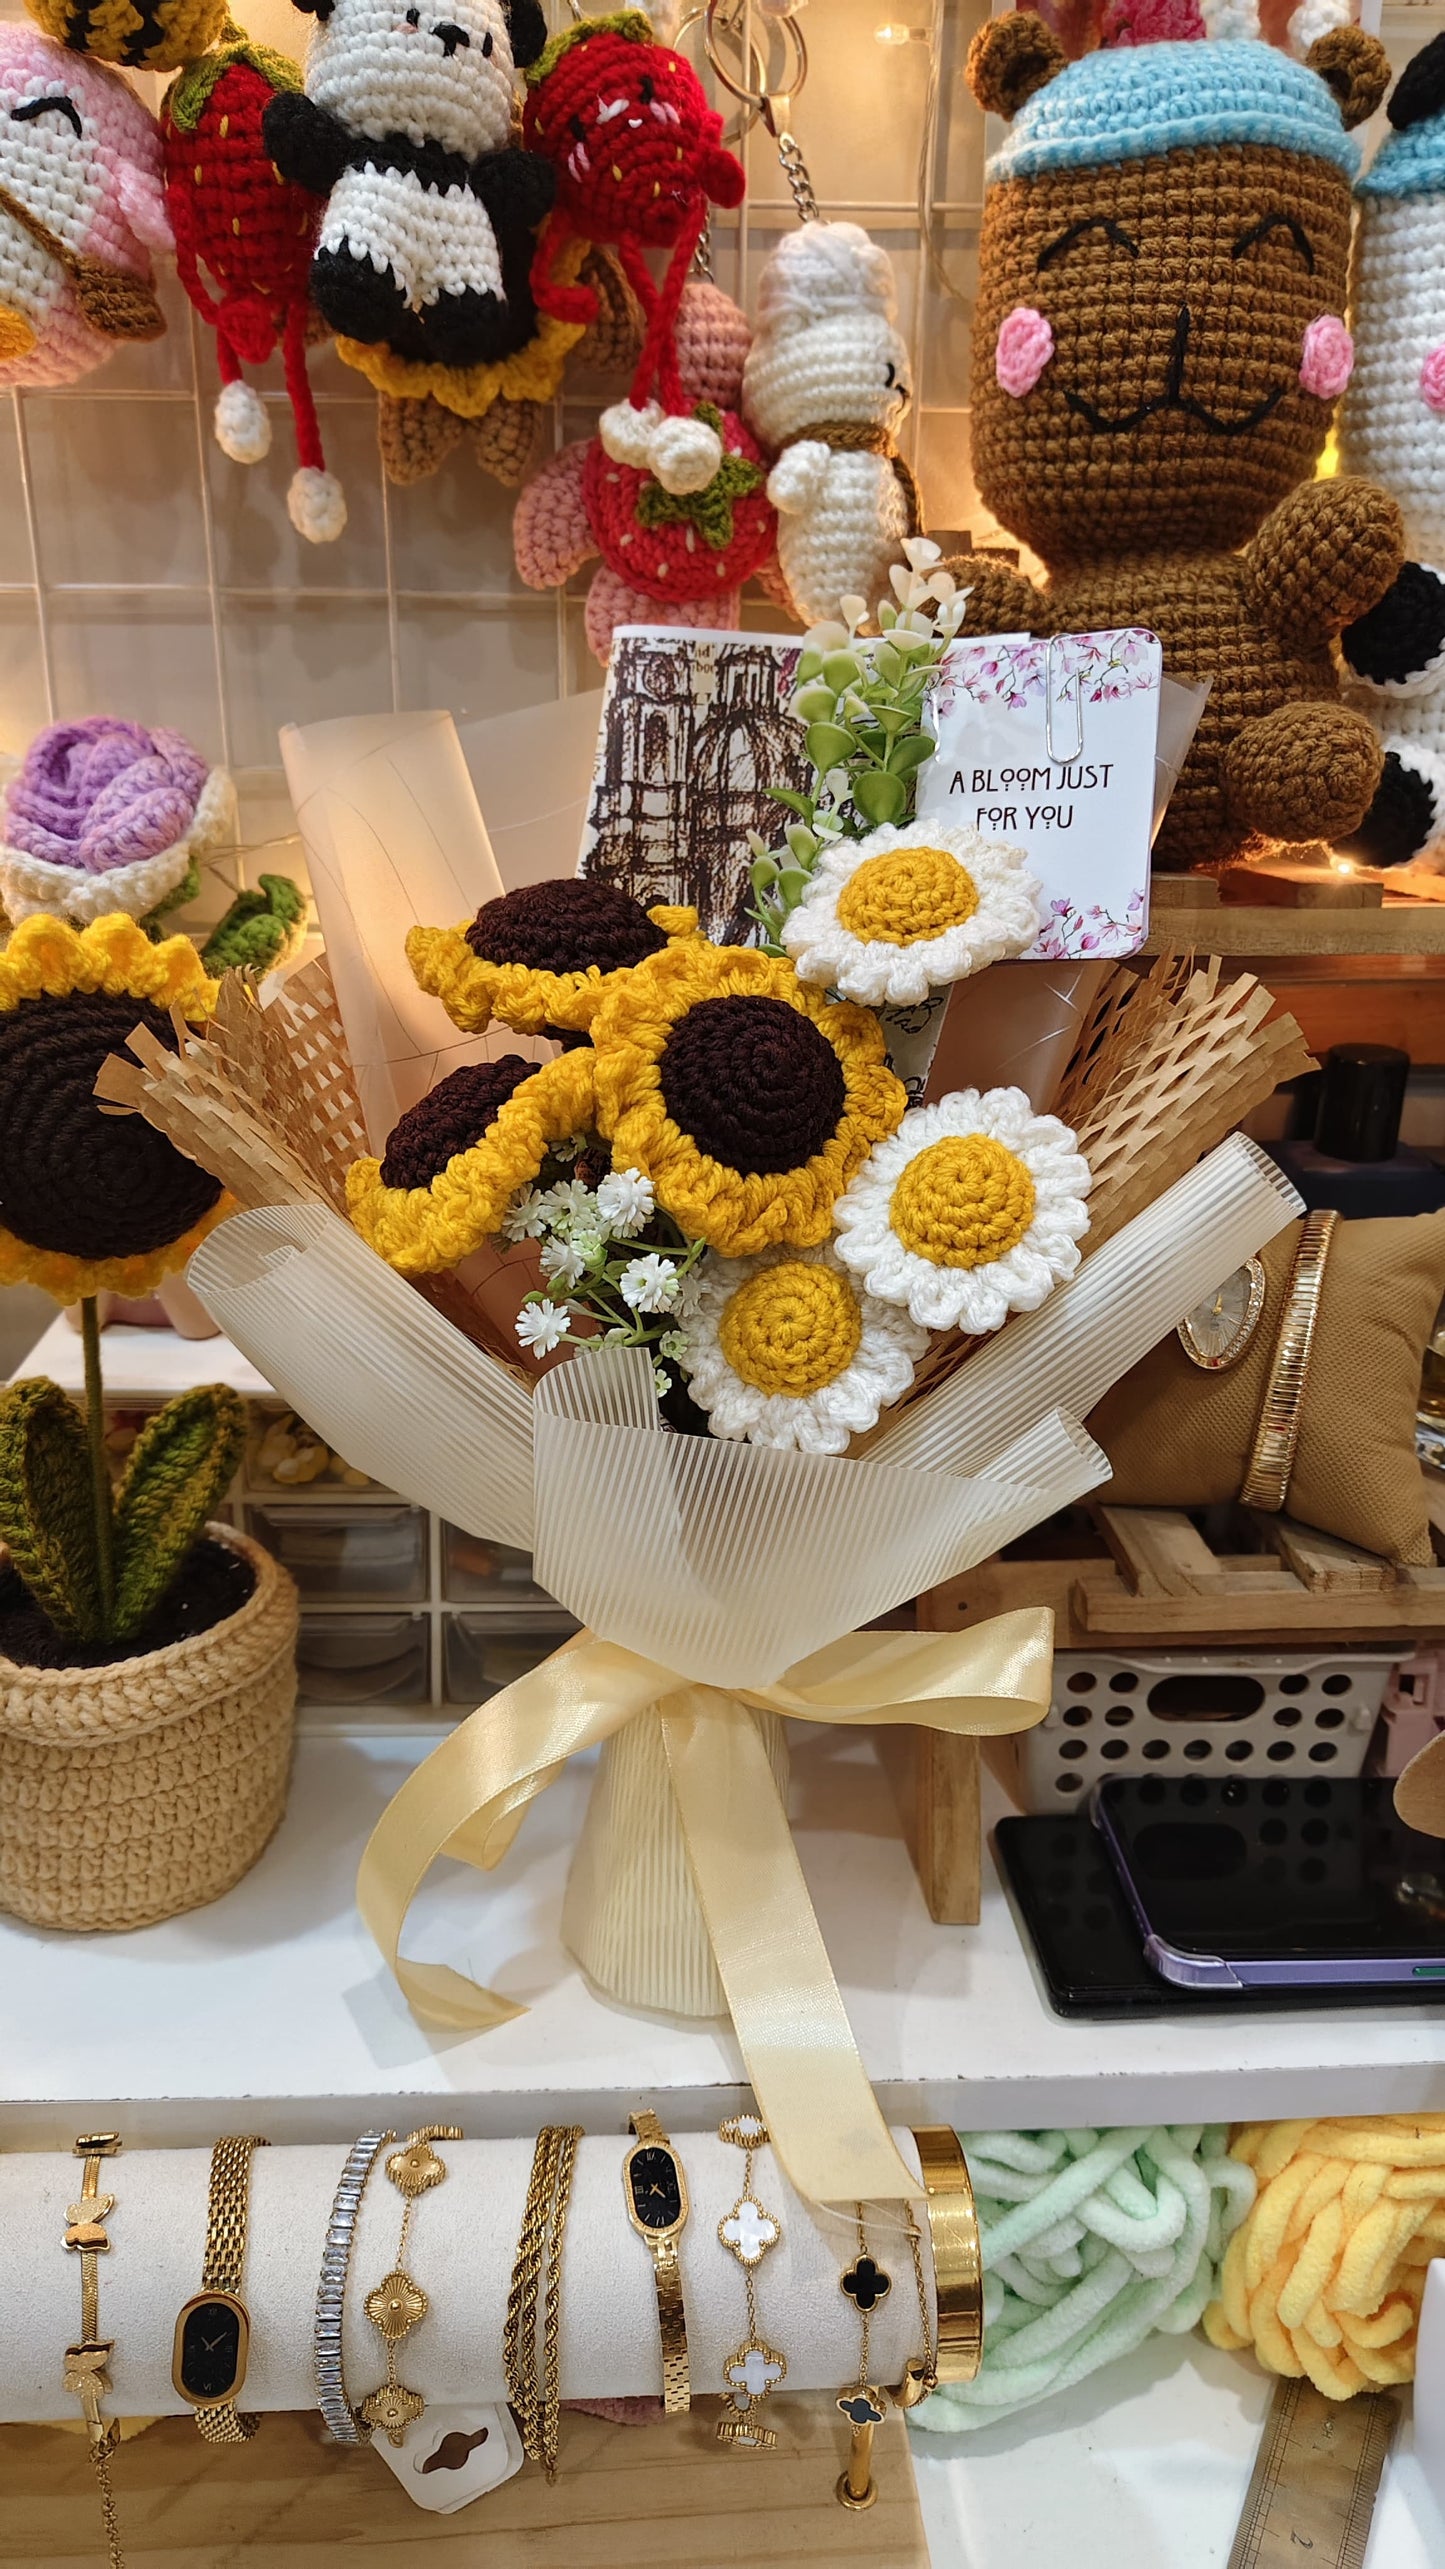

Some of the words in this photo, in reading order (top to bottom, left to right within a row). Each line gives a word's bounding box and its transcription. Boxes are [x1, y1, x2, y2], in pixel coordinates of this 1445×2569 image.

[949, 770, 965, 795] A
[971, 767, 1051, 793] BLOOM
[1056, 765, 1114, 790] JUST
[976, 806, 1018, 831] FOR
[1025, 805, 1073, 830] YOU
[1290, 2531, 1314, 2550] 2
